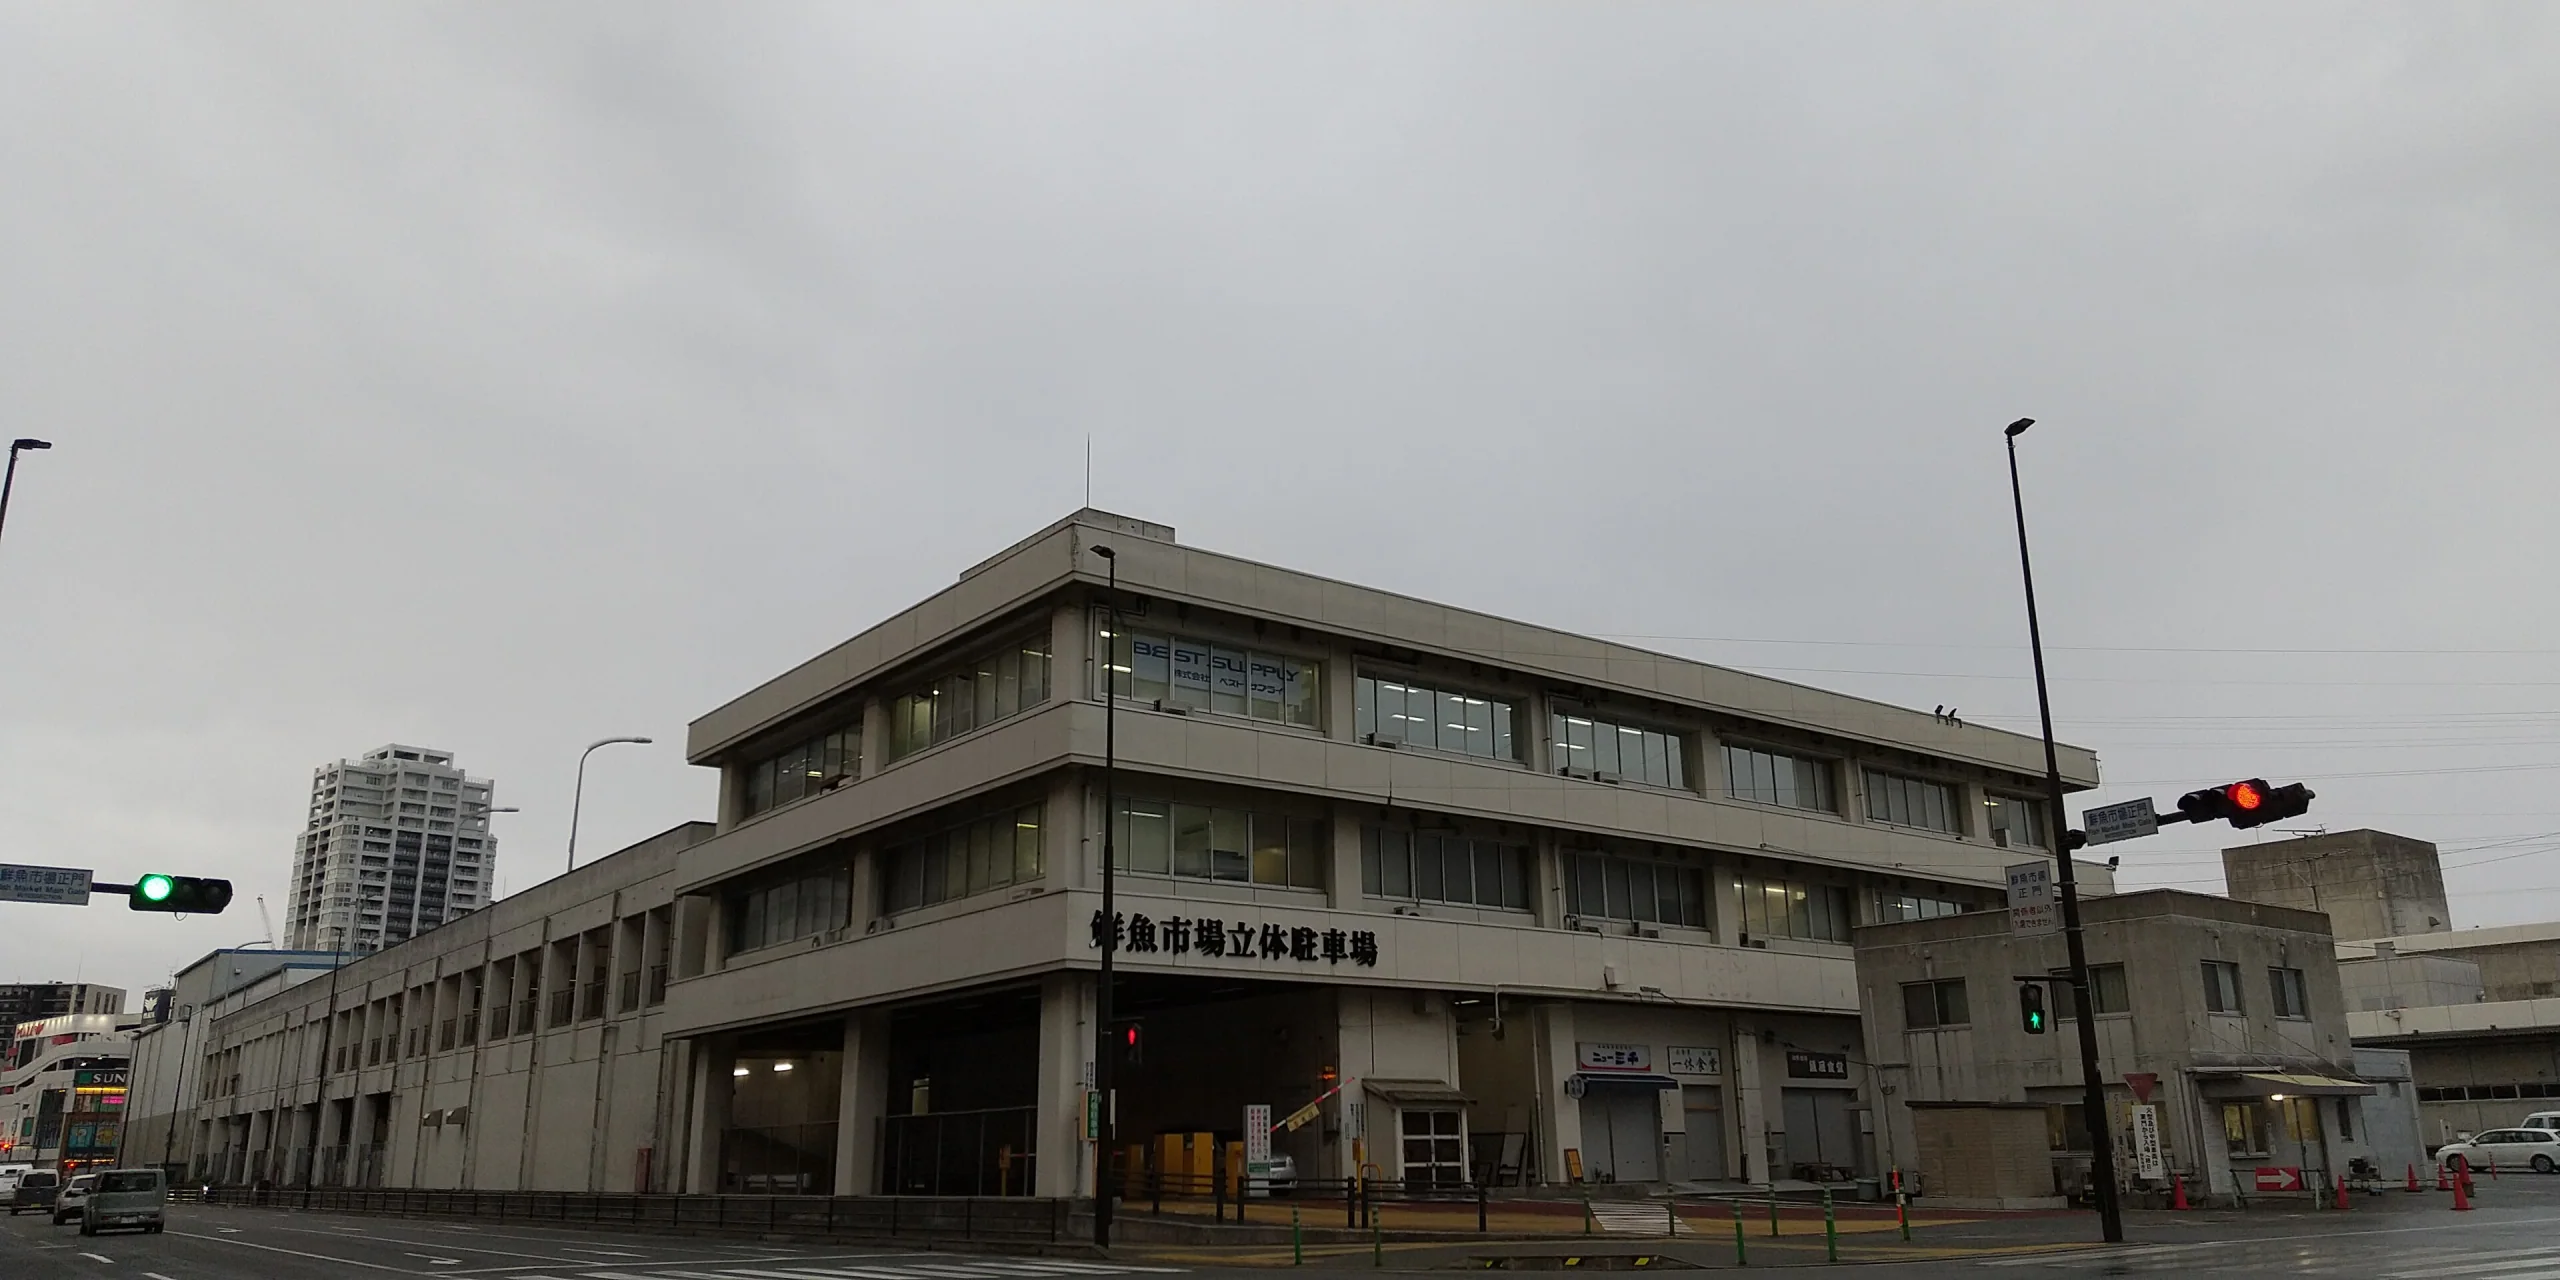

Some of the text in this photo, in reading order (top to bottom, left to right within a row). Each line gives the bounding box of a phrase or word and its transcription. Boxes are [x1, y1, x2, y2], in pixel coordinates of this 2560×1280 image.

[1133, 641, 1300, 682] BEST SUPPLY
[1174, 669, 1211, 684] 株式会社
[1219, 678, 1244, 689] ベスト
[2017, 885, 2043, 899] 正門
[1090, 909, 1379, 967] 鮮魚市場立体駐車場
